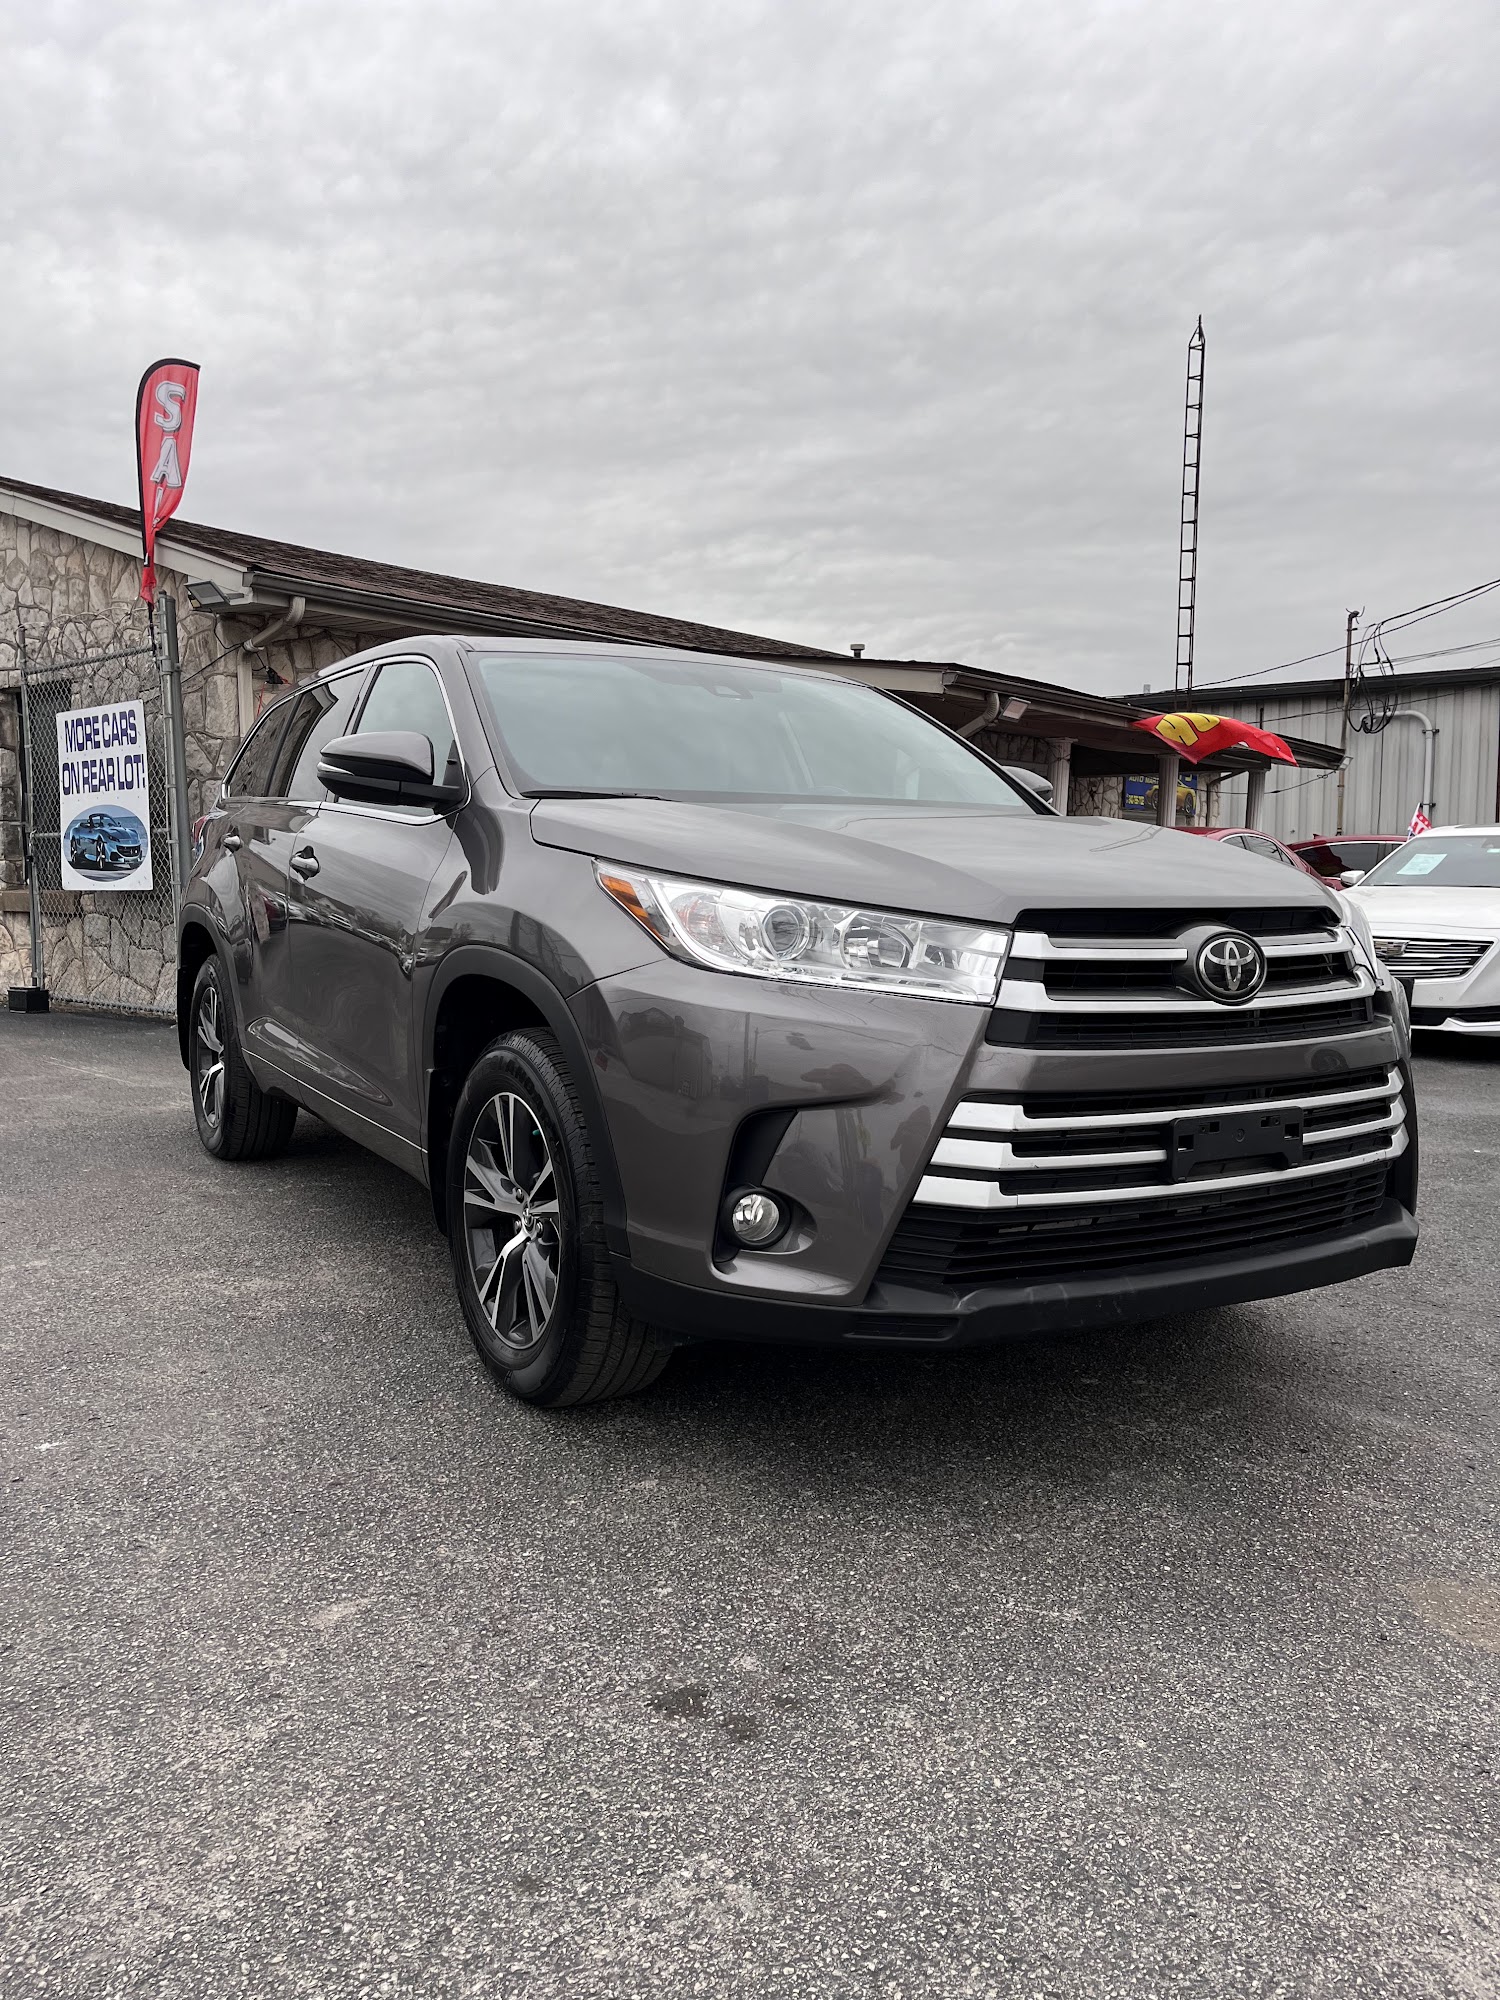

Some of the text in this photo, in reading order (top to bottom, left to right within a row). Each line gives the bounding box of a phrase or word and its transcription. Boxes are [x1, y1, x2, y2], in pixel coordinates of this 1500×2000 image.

[64, 709, 138, 753] MORE CARS
[62, 753, 146, 796] ON REAR LOT!
[1128, 775, 1144, 783] AUTO
